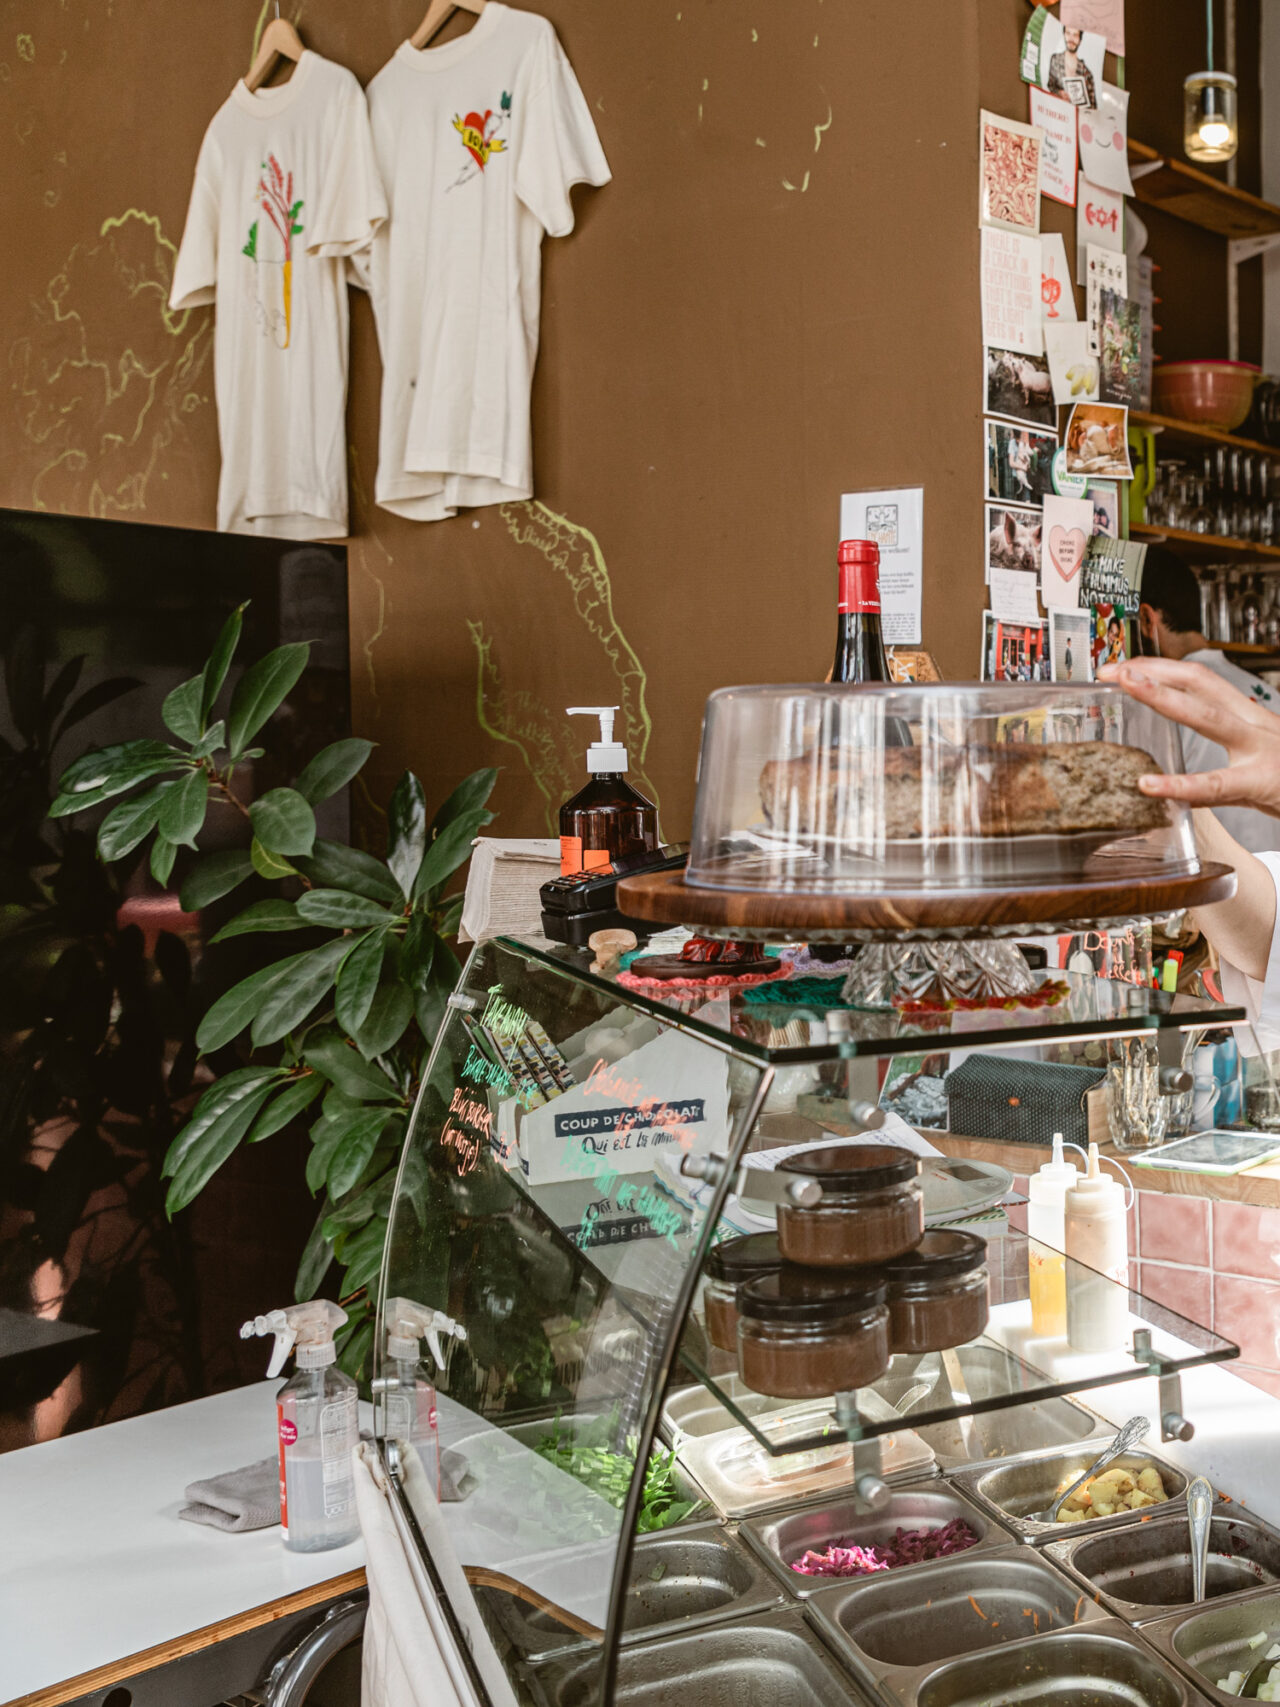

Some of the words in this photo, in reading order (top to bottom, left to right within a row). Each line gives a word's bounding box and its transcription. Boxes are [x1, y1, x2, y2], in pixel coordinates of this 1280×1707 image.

[1099, 555, 1125, 574] MAKE
[1090, 572, 1129, 595] HUMMUS
[1080, 588, 1106, 608] NOT
[560, 1117, 599, 1131] COUP
[603, 1113, 620, 1127] DE
